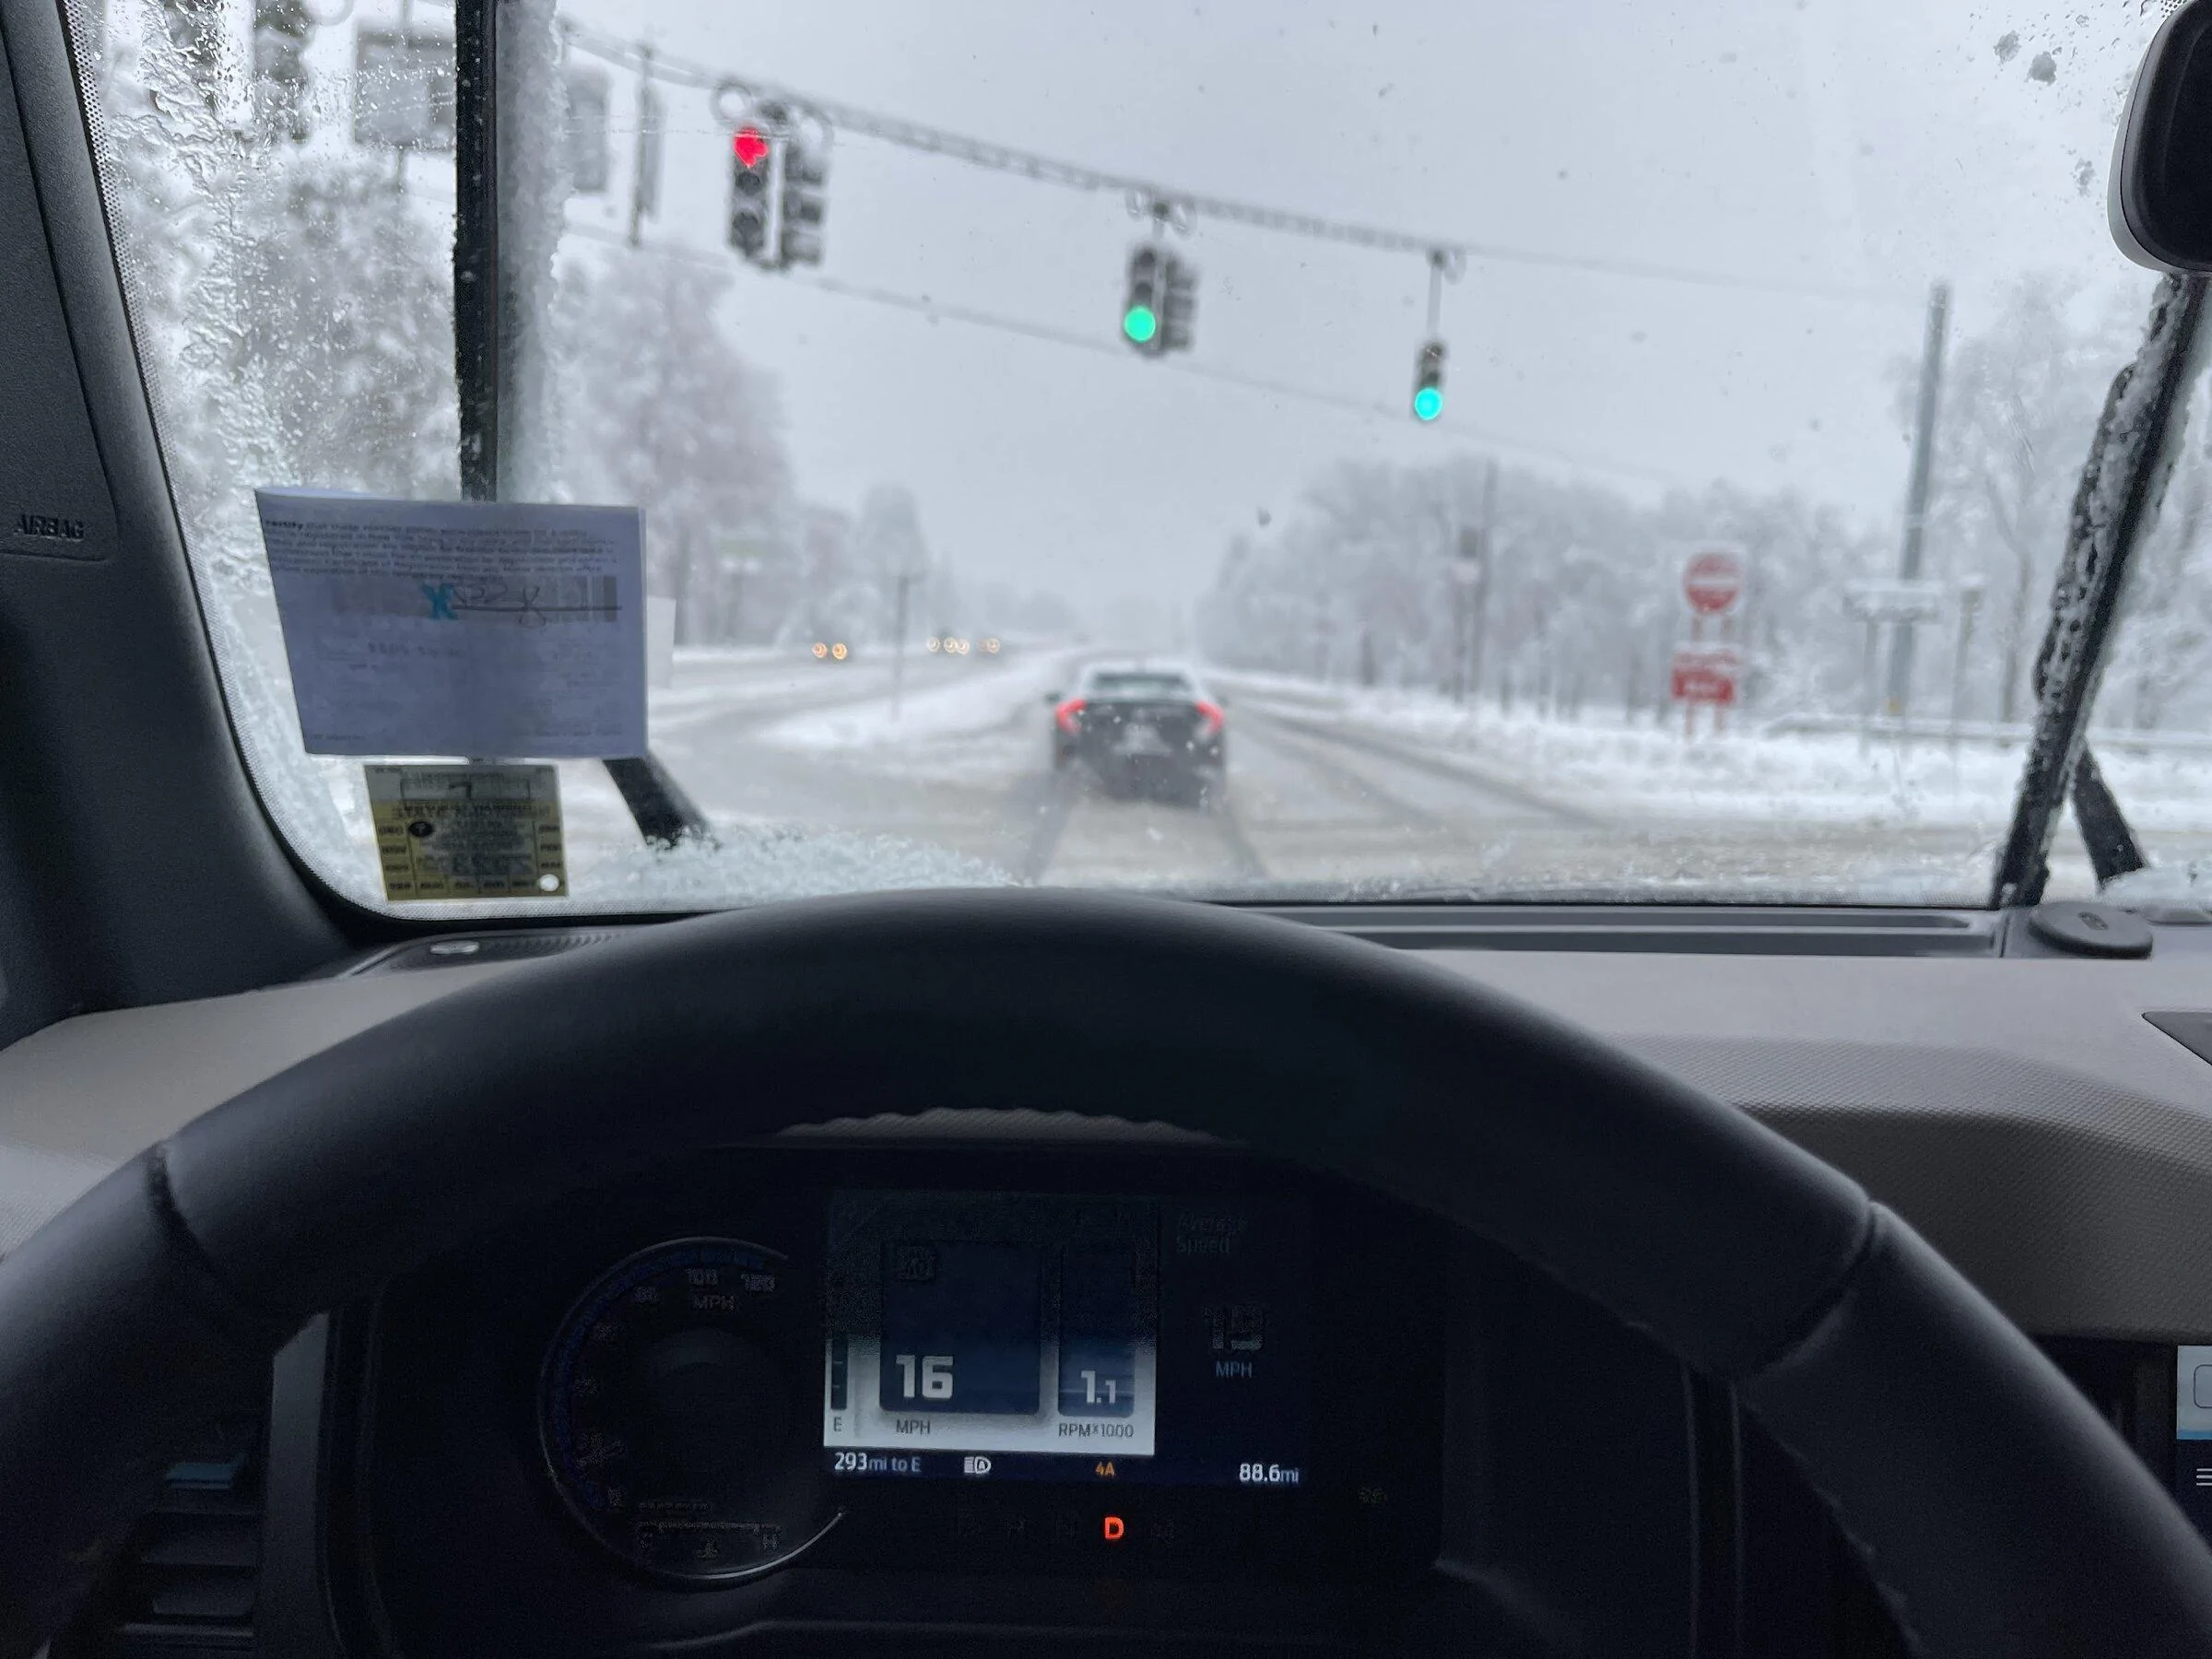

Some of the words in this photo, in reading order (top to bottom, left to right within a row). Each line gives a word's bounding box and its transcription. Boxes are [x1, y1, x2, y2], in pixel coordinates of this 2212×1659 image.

[13, 513, 85, 540] AIRBAG
[895, 1354, 954, 1400] 16
[1215, 1360, 1253, 1378] MPH
[1081, 1370, 1115, 1404] 1.1
[833, 1417, 843, 1432] E
[896, 1418, 931, 1435] MPH
[891, 1457, 908, 1472] to
[911, 1457, 921, 1472] E
[1095, 1461, 1115, 1476] 4A
[1103, 1517, 1125, 1540] D
